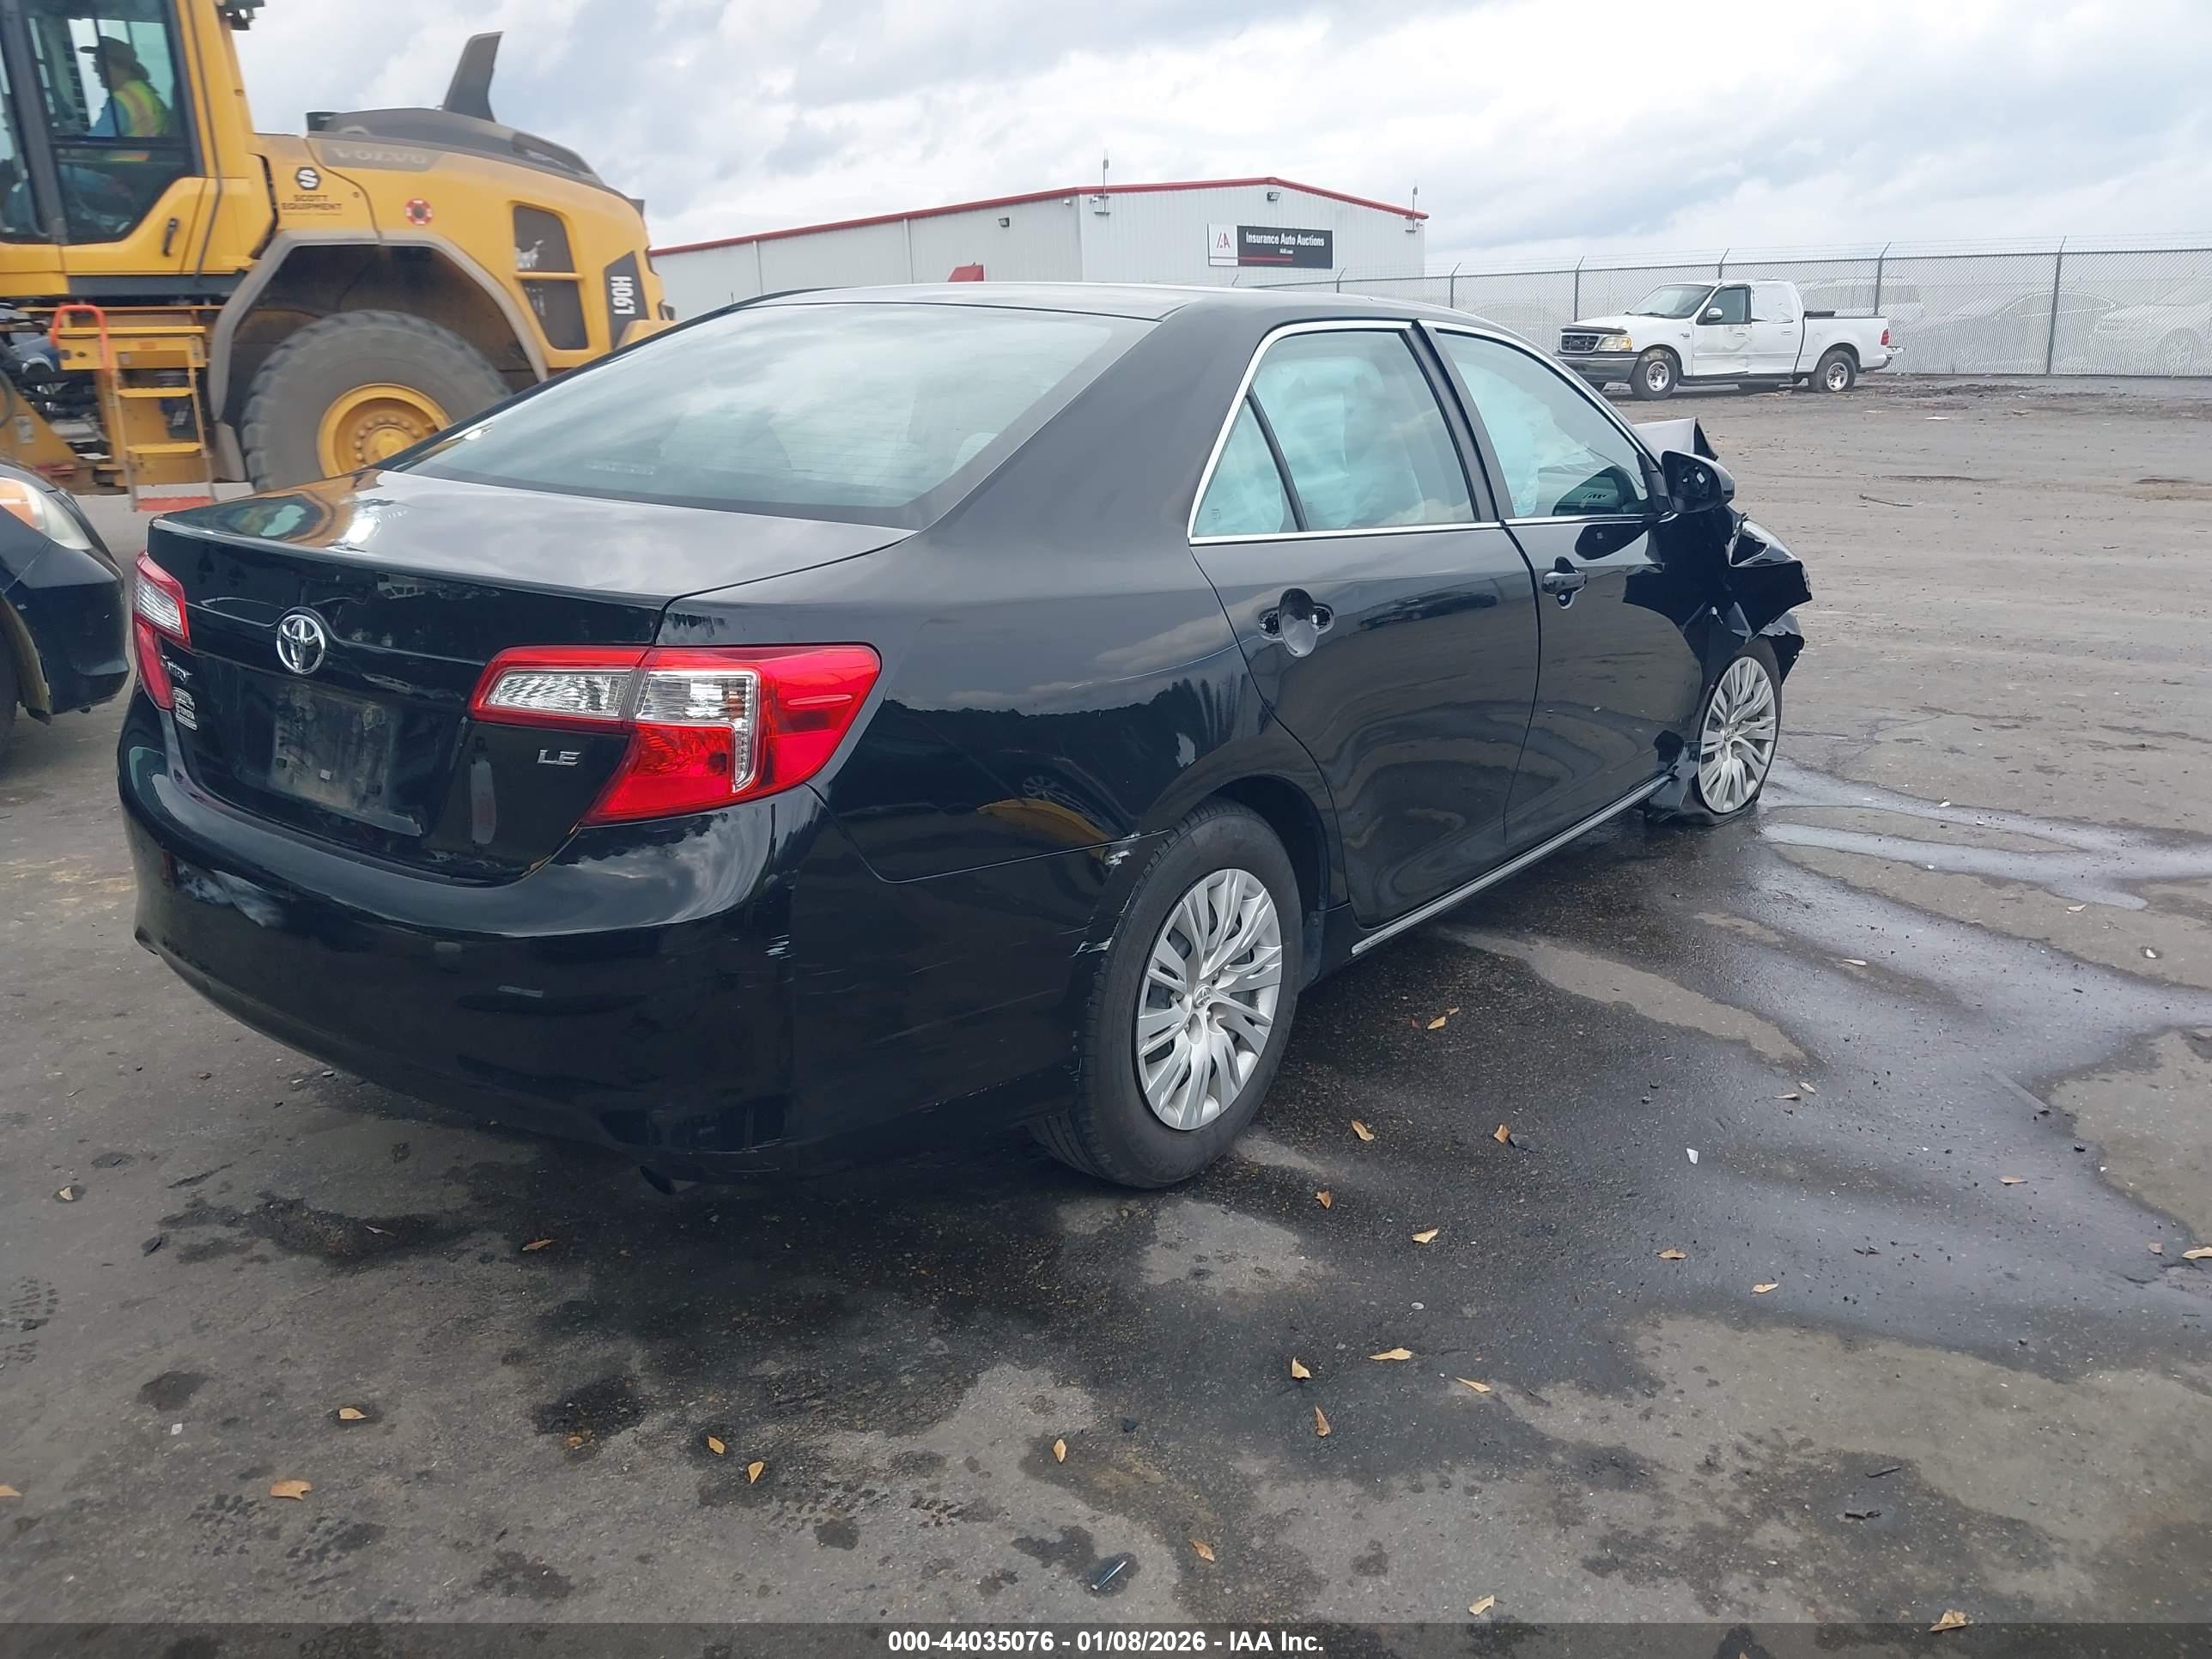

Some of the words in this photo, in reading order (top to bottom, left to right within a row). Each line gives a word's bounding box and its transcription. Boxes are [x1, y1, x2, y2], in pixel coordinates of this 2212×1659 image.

[331, 148, 427, 164] VOLVO
[1246, 231, 1279, 246] Insurance
[1280, 233, 1296, 246] Auto
[1297, 234, 1324, 246] Auctions
[611, 276, 635, 314] L90H
[537, 749, 581, 767] LE
